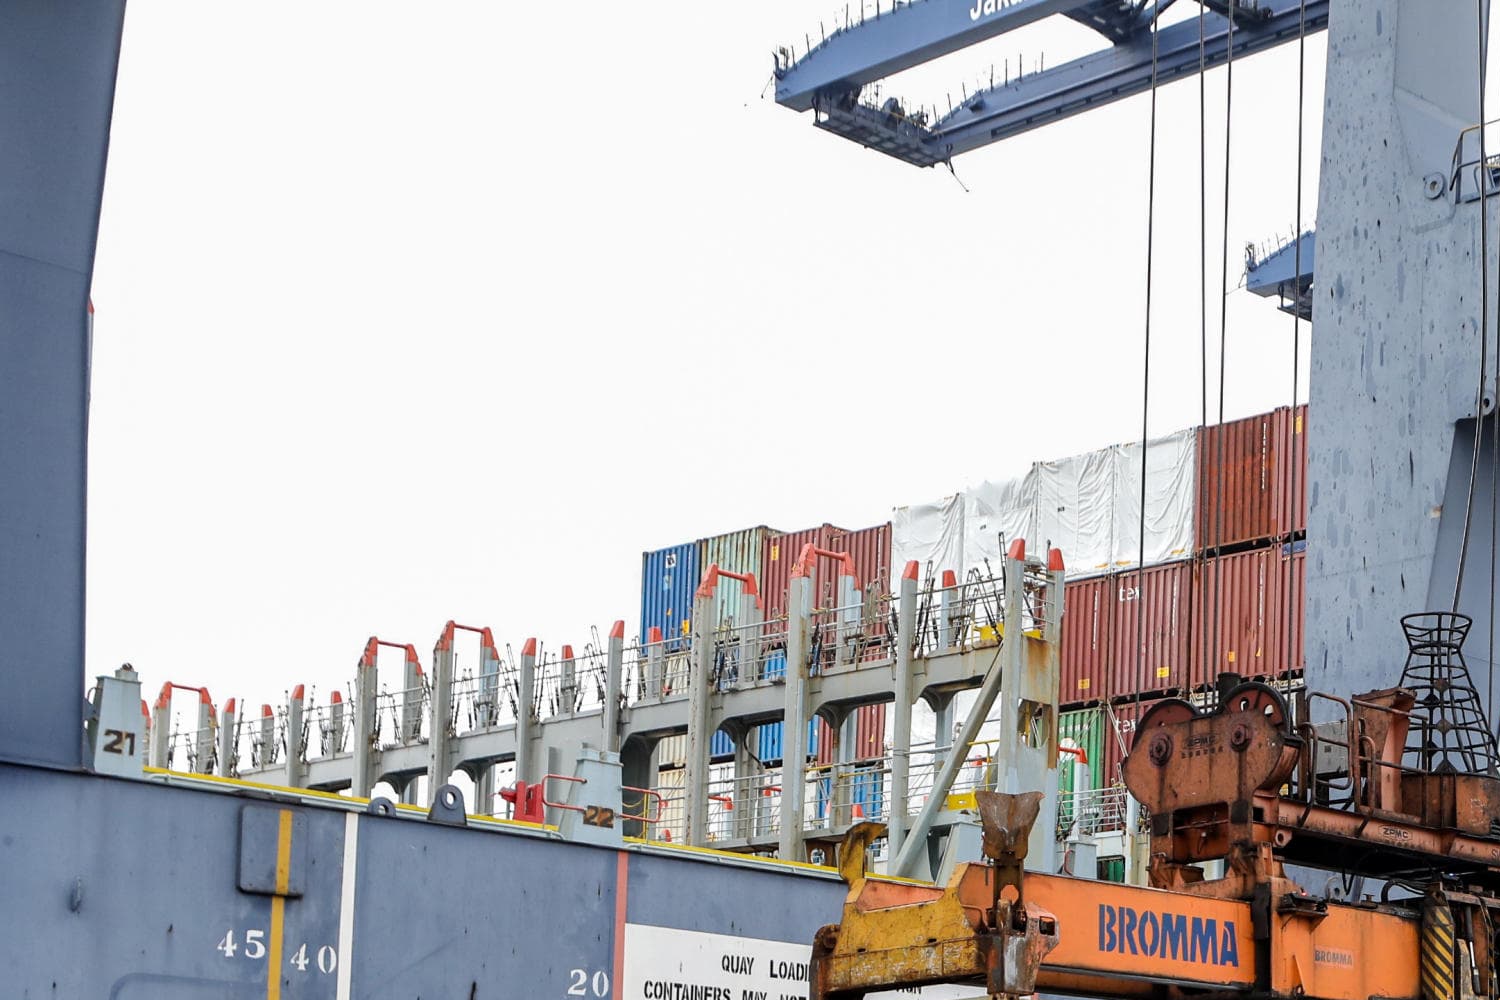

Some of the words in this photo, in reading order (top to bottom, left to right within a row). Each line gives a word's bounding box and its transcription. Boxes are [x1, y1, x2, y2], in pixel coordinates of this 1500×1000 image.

[103, 729, 136, 756] 21
[1383, 827, 1409, 839] ZPMC
[217, 929, 266, 959] 45
[1098, 903, 1239, 968] BROMMA
[290, 943, 337, 974] 40
[721, 954, 755, 977] QUAY
[769, 959, 810, 983] LOADI
[1314, 949, 1353, 966] BROMMA
[567, 968, 609, 998] 20
